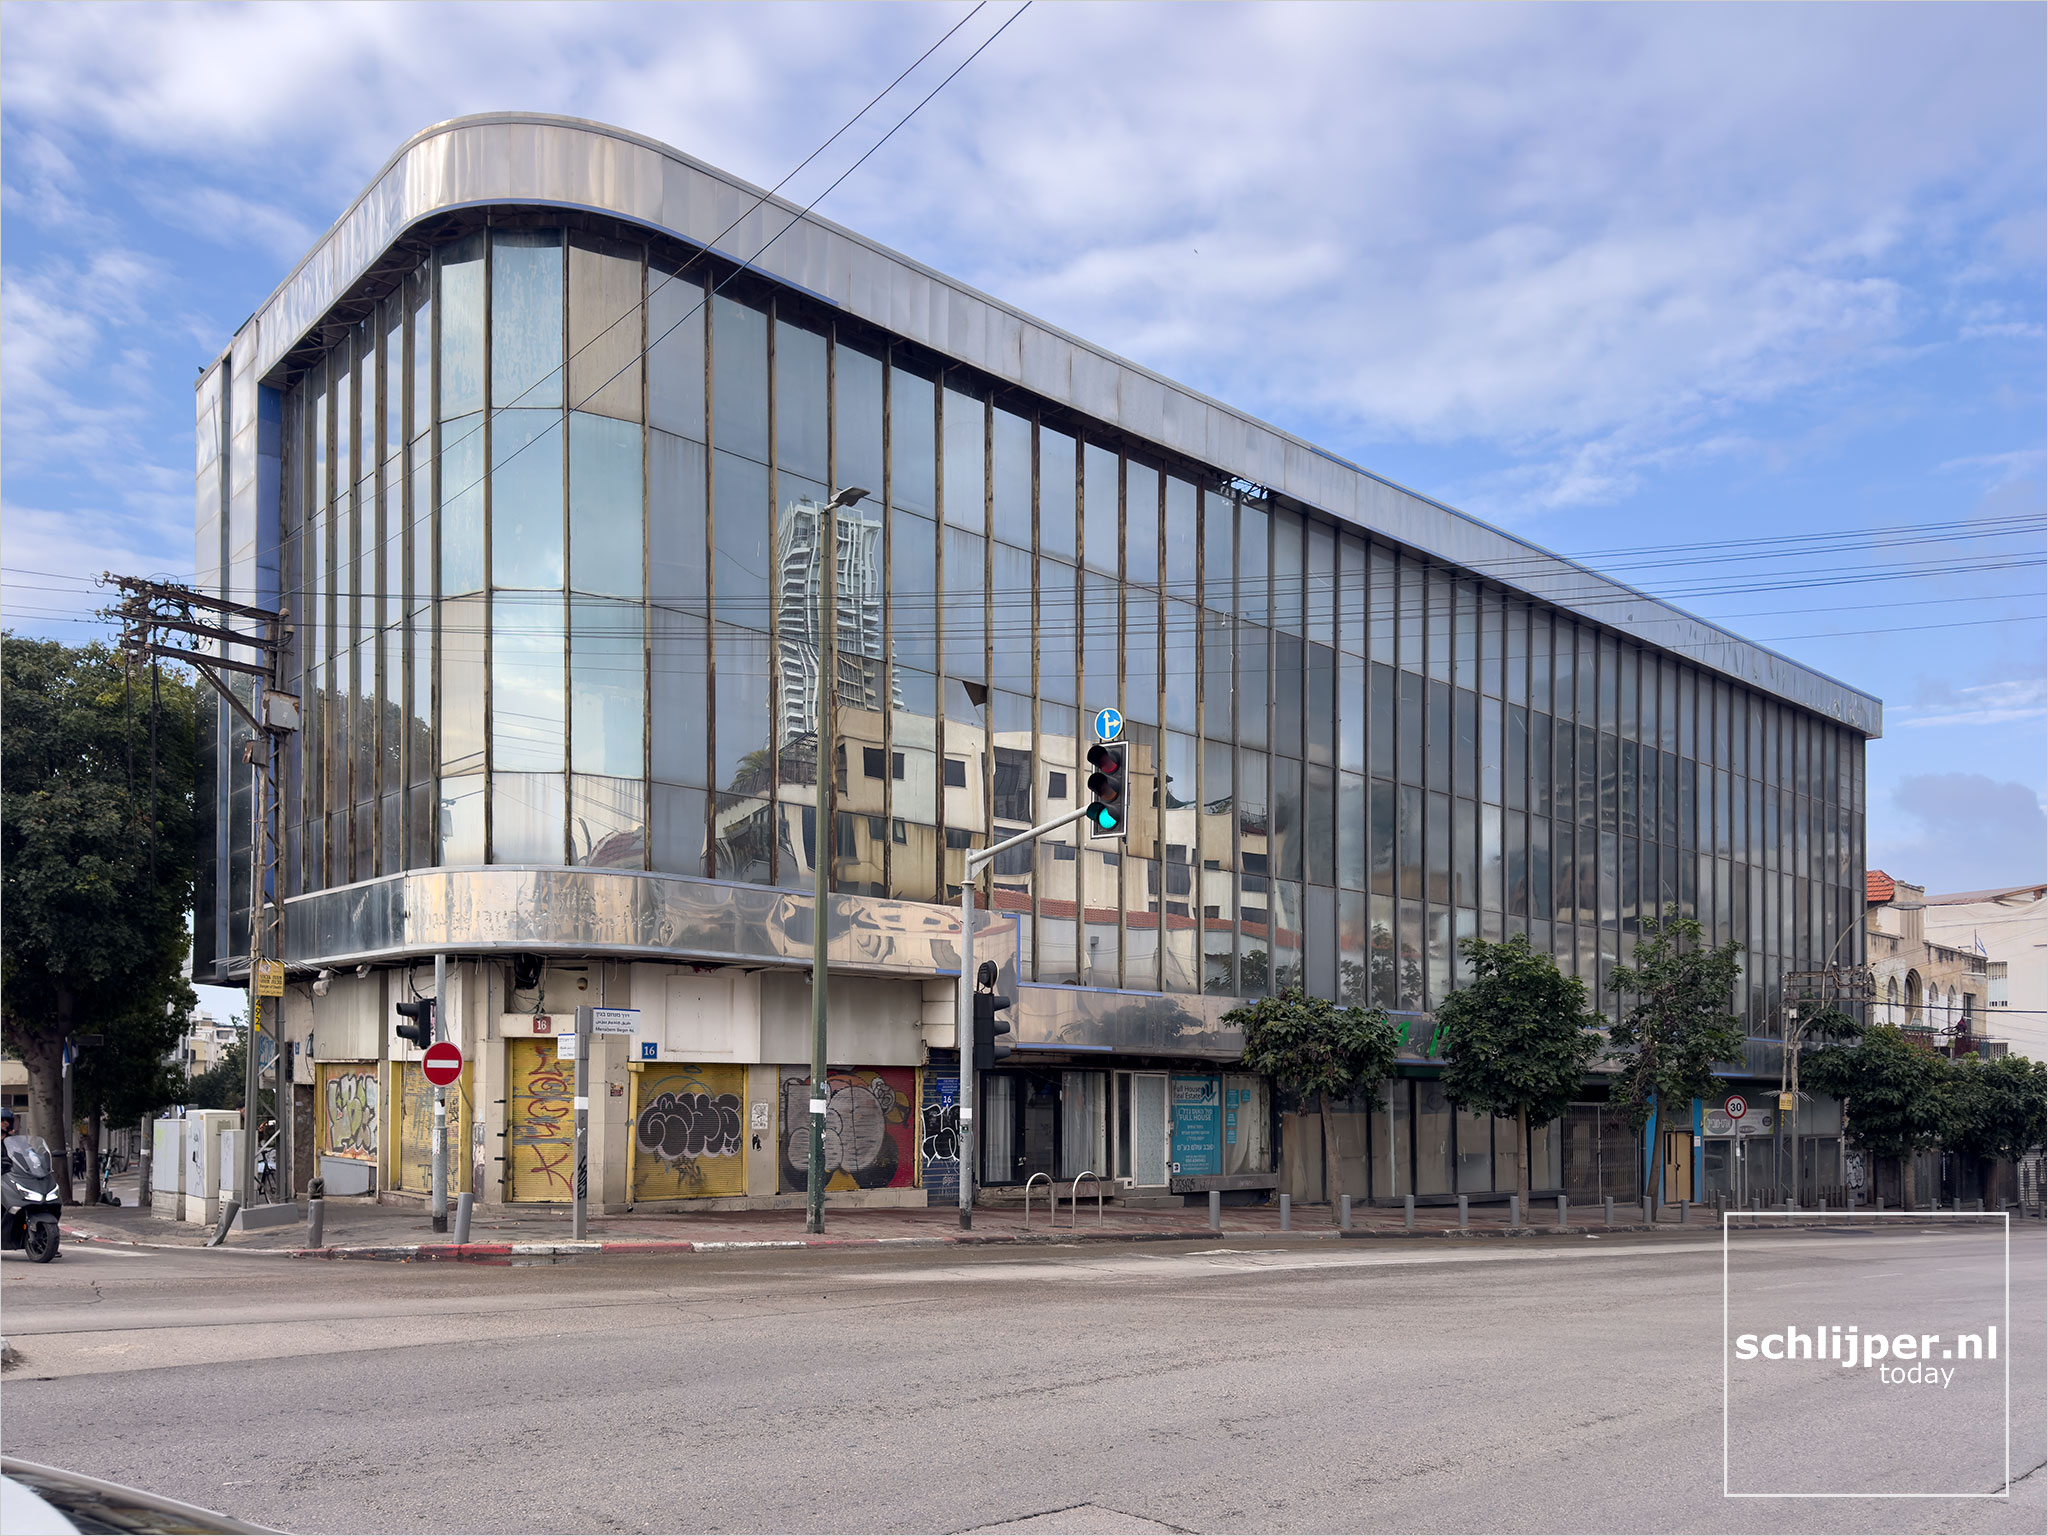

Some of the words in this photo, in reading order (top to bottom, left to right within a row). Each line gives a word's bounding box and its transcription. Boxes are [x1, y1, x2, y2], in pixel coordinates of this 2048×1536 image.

[537, 1020, 547, 1030] 16
[643, 1046, 656, 1056] 16
[1730, 1103, 1742, 1112] 30
